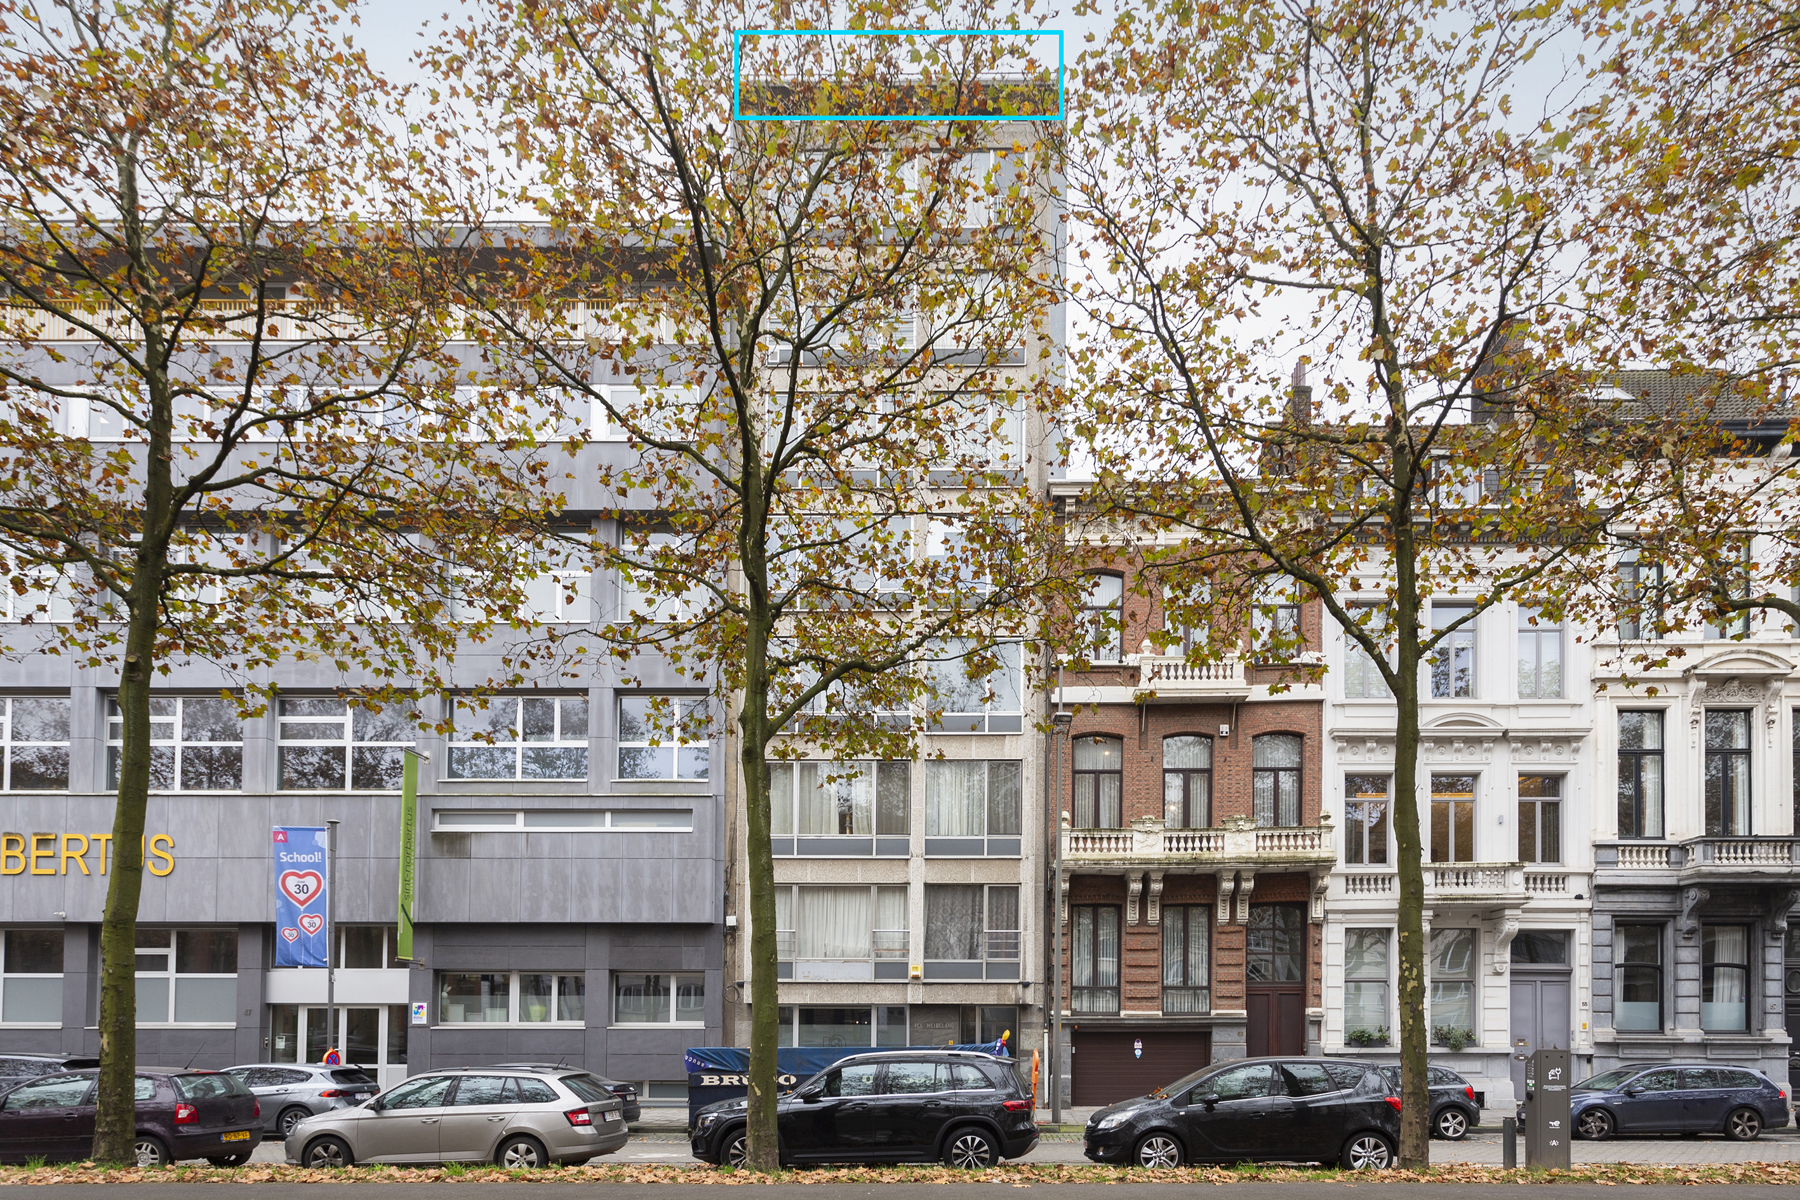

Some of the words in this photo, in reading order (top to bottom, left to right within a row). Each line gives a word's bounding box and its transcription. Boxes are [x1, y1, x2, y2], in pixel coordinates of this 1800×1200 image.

[0, 832, 175, 876] BERTS
[279, 851, 322, 863] School!
[403, 806, 413, 901] sint-norbertus
[294, 883, 309, 895] 30
[307, 921, 316, 929] 30
[700, 1074, 797, 1086] BRO
